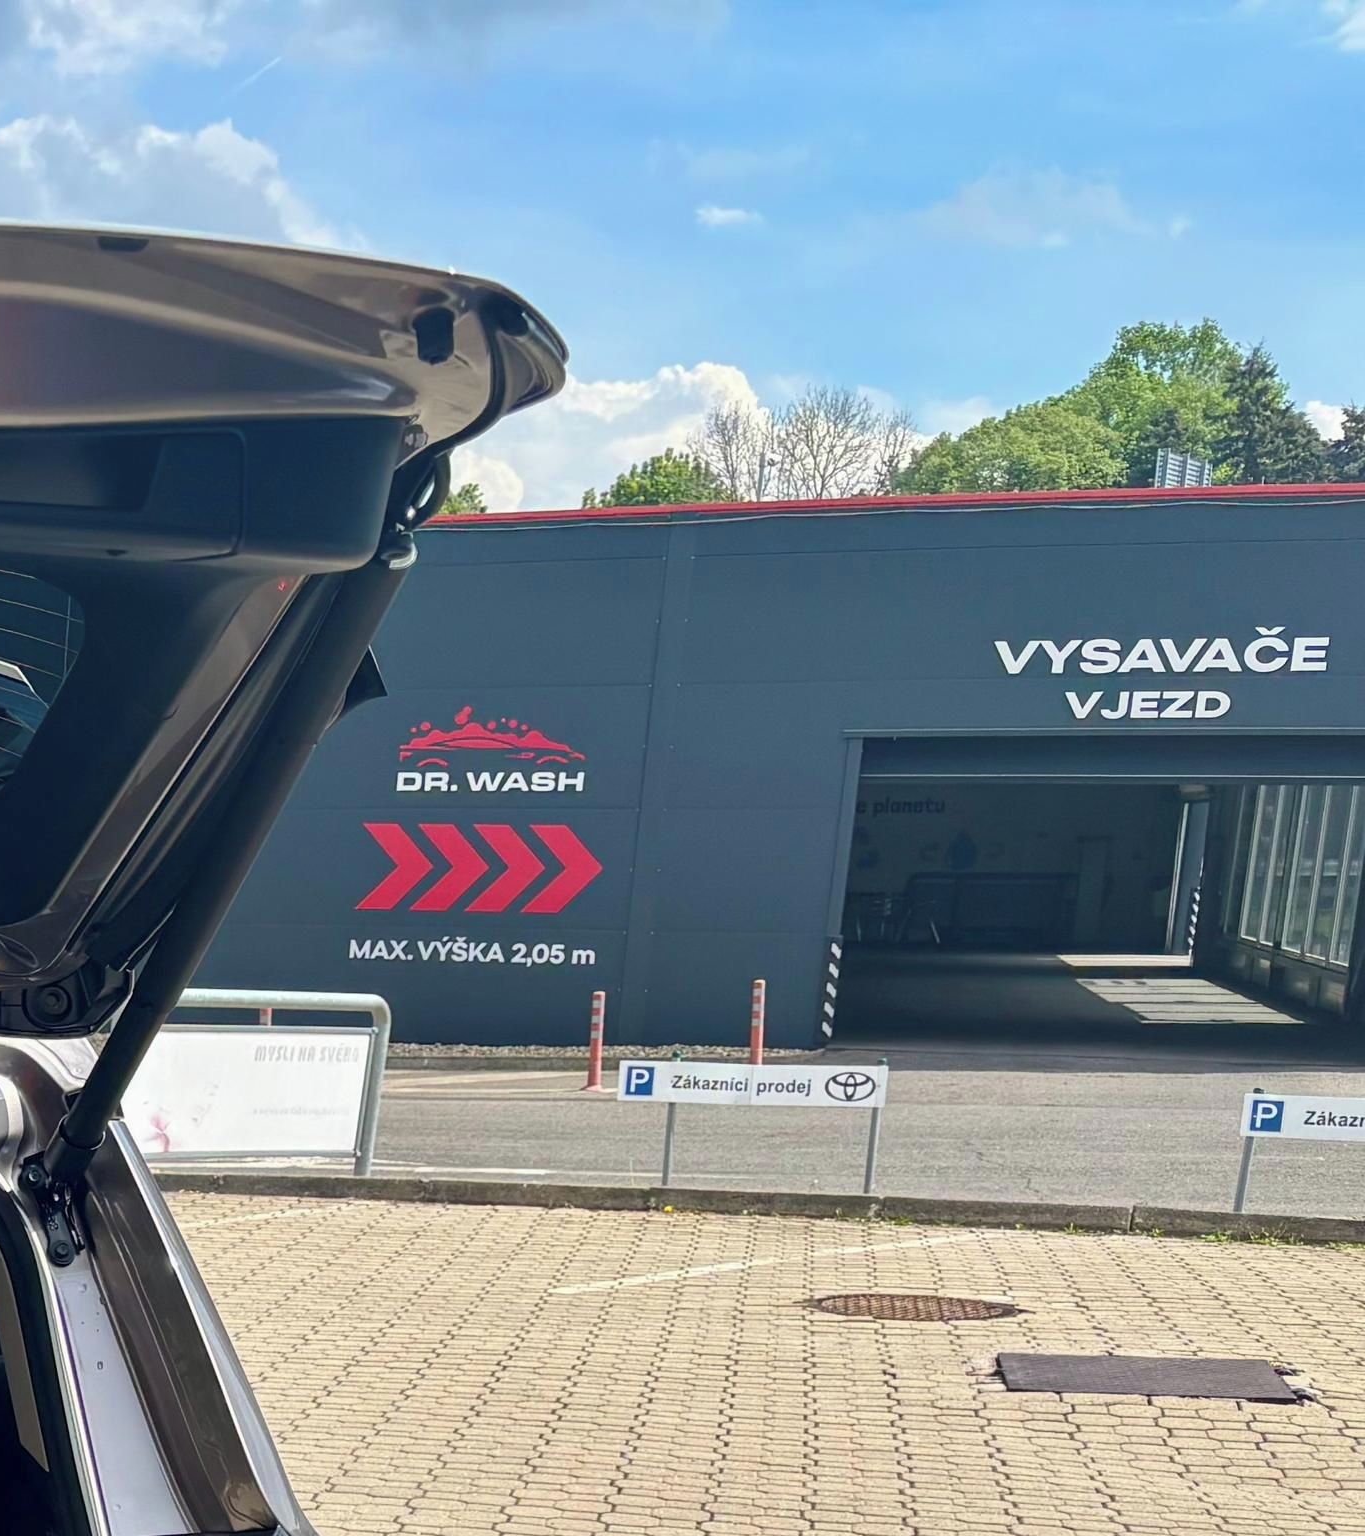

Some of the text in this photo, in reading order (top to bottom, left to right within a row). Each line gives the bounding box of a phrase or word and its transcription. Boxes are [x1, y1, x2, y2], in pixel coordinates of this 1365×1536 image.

[994, 626, 1330, 675] VYSAVAČE
[1065, 691, 1231, 720] VJEZD
[396, 771, 585, 792] DR. WASH
[348, 936, 596, 967] MAX. VÝŠKA 2,05 m
[629, 1069, 812, 1097] P Zákazníci prodej
[1255, 1102, 1278, 1129] P
